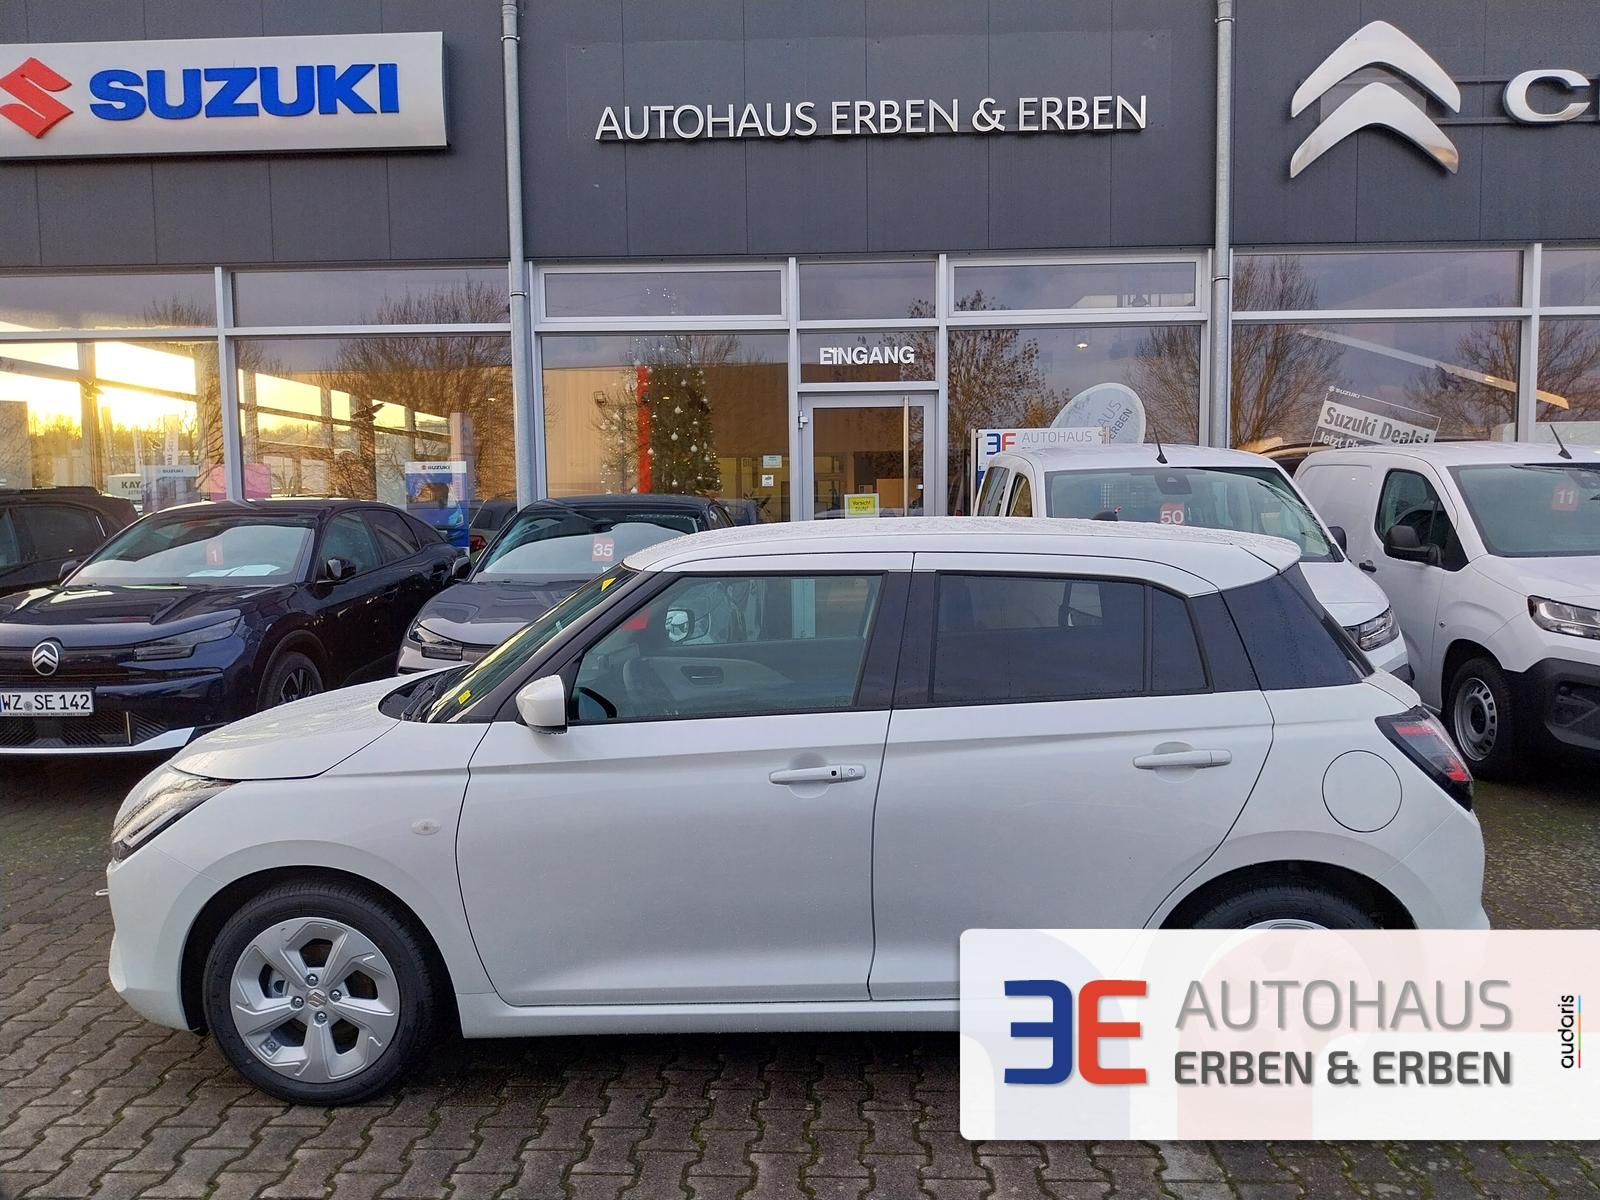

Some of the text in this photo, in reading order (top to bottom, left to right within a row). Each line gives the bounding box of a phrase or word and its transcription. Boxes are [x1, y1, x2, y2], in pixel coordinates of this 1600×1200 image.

[89, 63, 400, 121] SUZUKI
[594, 95, 1147, 140] AUTOHAUS ERBEN & ERBEN
[819, 346, 915, 365] EINGANG
[1324, 406, 1379, 437] Suzuki
[1021, 431, 1093, 443] AUTOHAUS
[1556, 488, 1575, 505] 11
[1159, 509, 1185, 525] 50
[593, 543, 614, 558] 35
[1, 694, 91, 710] WZ SE 142
